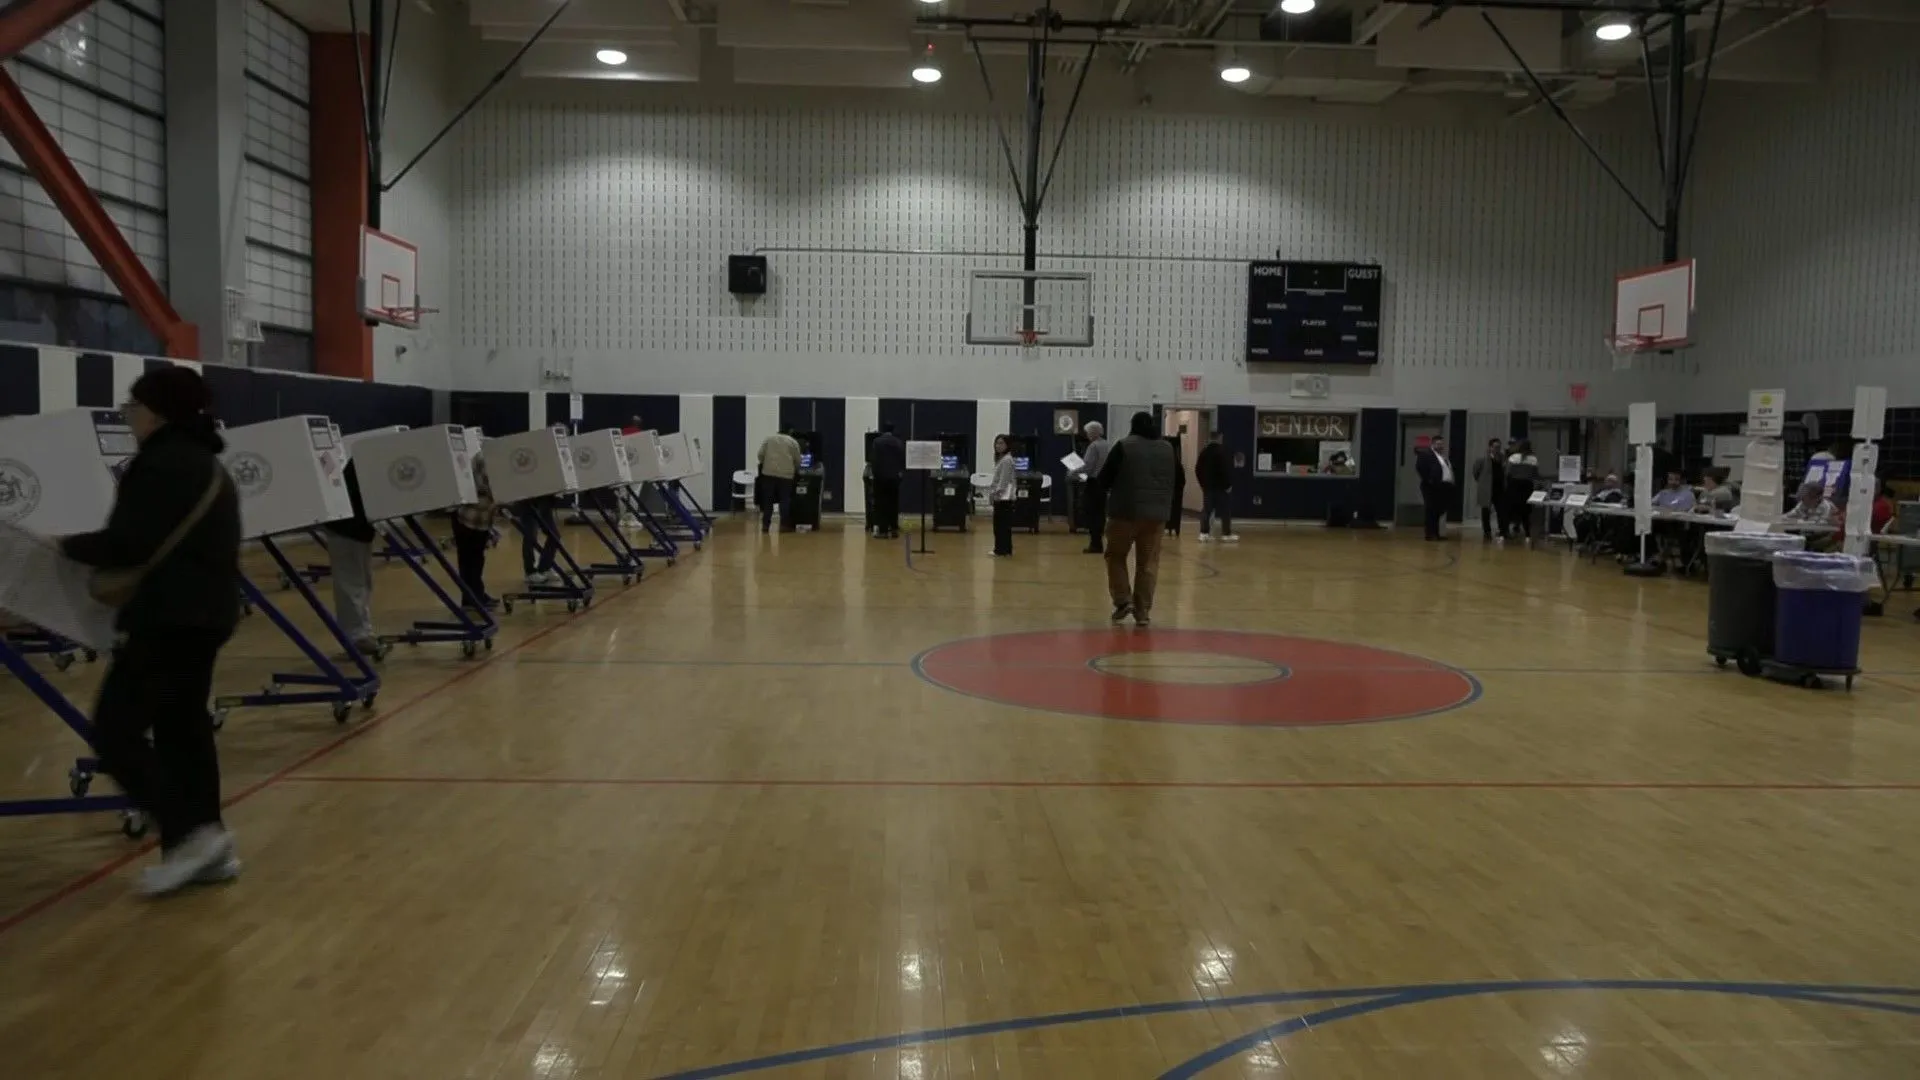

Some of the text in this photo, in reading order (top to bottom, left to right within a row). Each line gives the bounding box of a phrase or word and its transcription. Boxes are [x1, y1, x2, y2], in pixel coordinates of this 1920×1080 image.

[1254, 266, 1282, 276] HOME
[1347, 268, 1379, 279] GUEST
[1261, 415, 1345, 437] SENIOR
